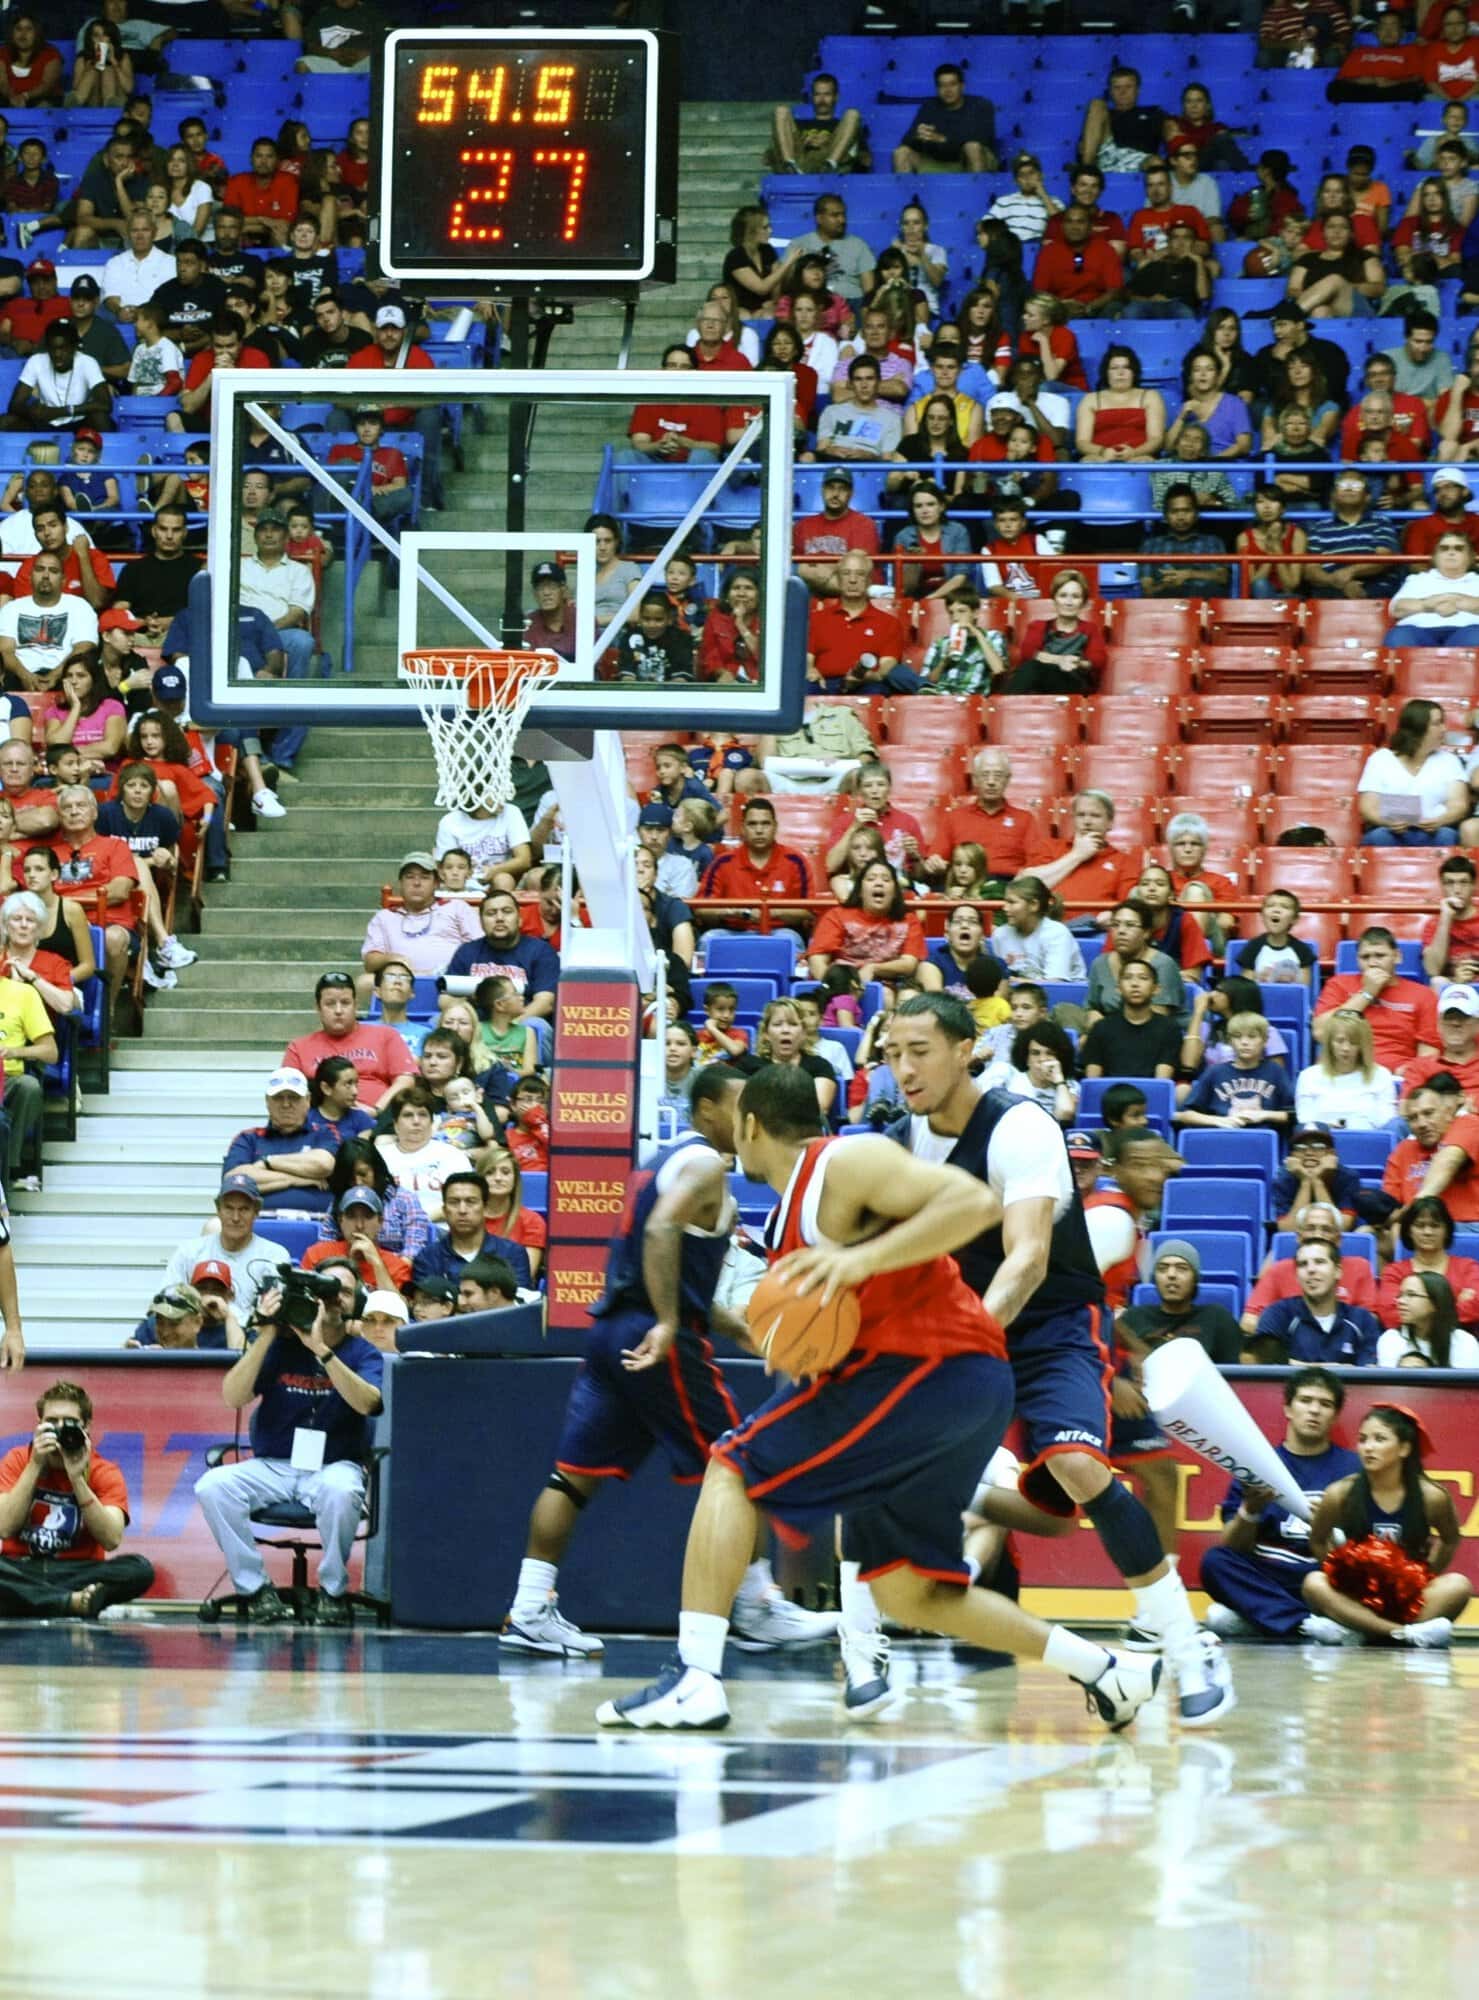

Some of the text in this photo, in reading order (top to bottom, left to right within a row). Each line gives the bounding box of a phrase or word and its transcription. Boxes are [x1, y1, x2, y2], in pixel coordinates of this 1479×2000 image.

[418, 66, 576, 122] 54.5
[449, 151, 586, 240] 27
[561, 1006, 632, 1020] WELLS
[562, 1023, 630, 1037] FARGO
[1214, 1077, 1276, 1101] ARIZONA
[558, 1092, 628, 1106] WELLS
[559, 1109, 626, 1123] FARGO
[555, 1180, 624, 1195] WELLS
[556, 1198, 624, 1213] FARGO
[553, 1270, 607, 1286] WELL
